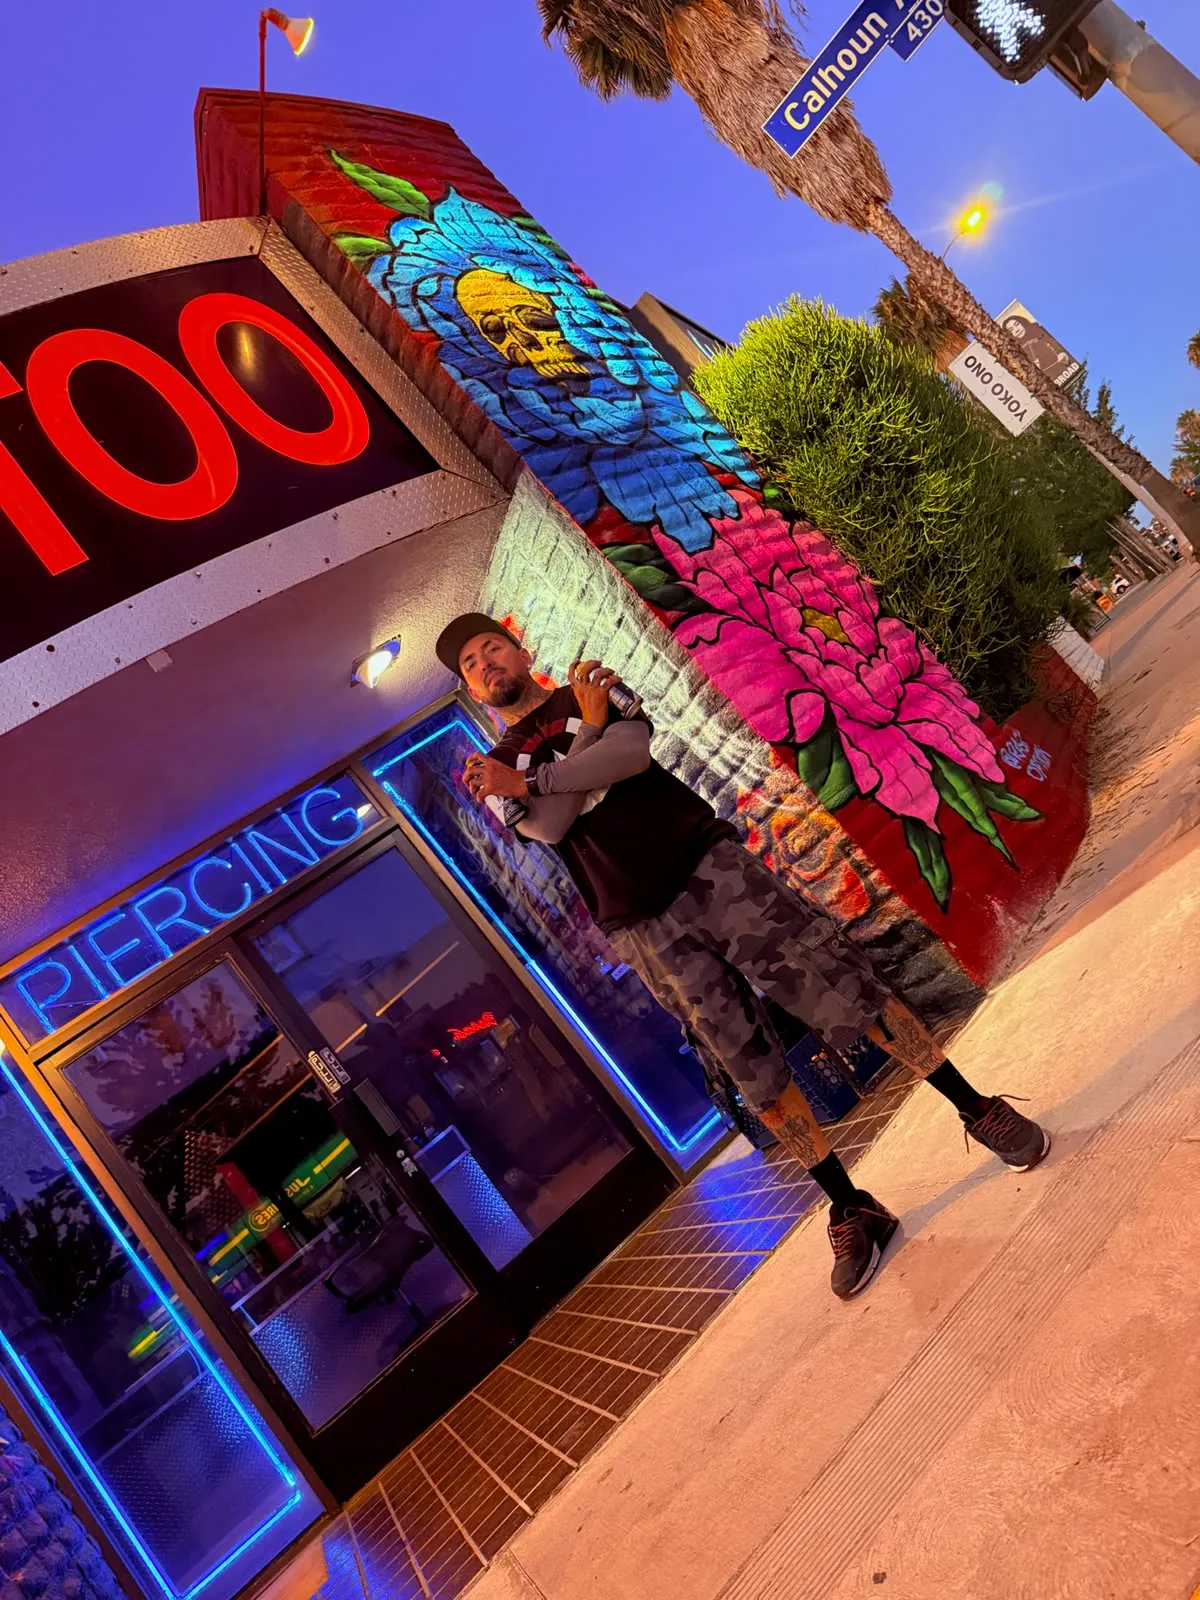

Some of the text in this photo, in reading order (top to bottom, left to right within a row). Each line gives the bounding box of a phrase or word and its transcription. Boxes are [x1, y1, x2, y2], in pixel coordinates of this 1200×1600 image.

[784, 12, 888, 130] Calhoun
[964, 355, 1028, 422] YOKO ONO
[1053, 362, 1080, 387] BROAD
[16, 787, 364, 1034] PIERCING
[311, 1057, 333, 1083] PULL
[324, 1051, 344, 1078] PULL
